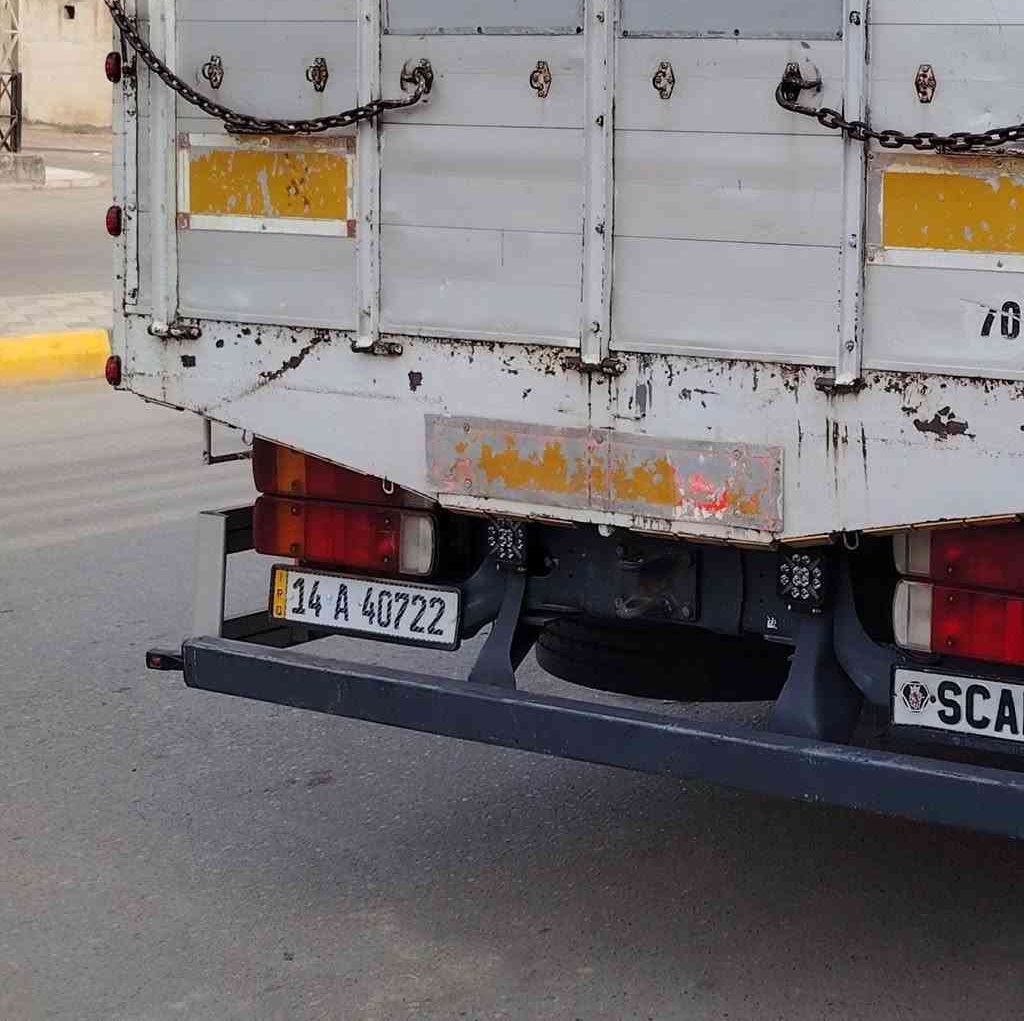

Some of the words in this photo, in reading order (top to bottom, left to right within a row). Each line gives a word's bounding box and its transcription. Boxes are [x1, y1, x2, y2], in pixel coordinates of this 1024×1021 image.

[292, 578, 322, 617] 14
[334, 583, 349, 621] A
[361, 587, 446, 635] 40722
